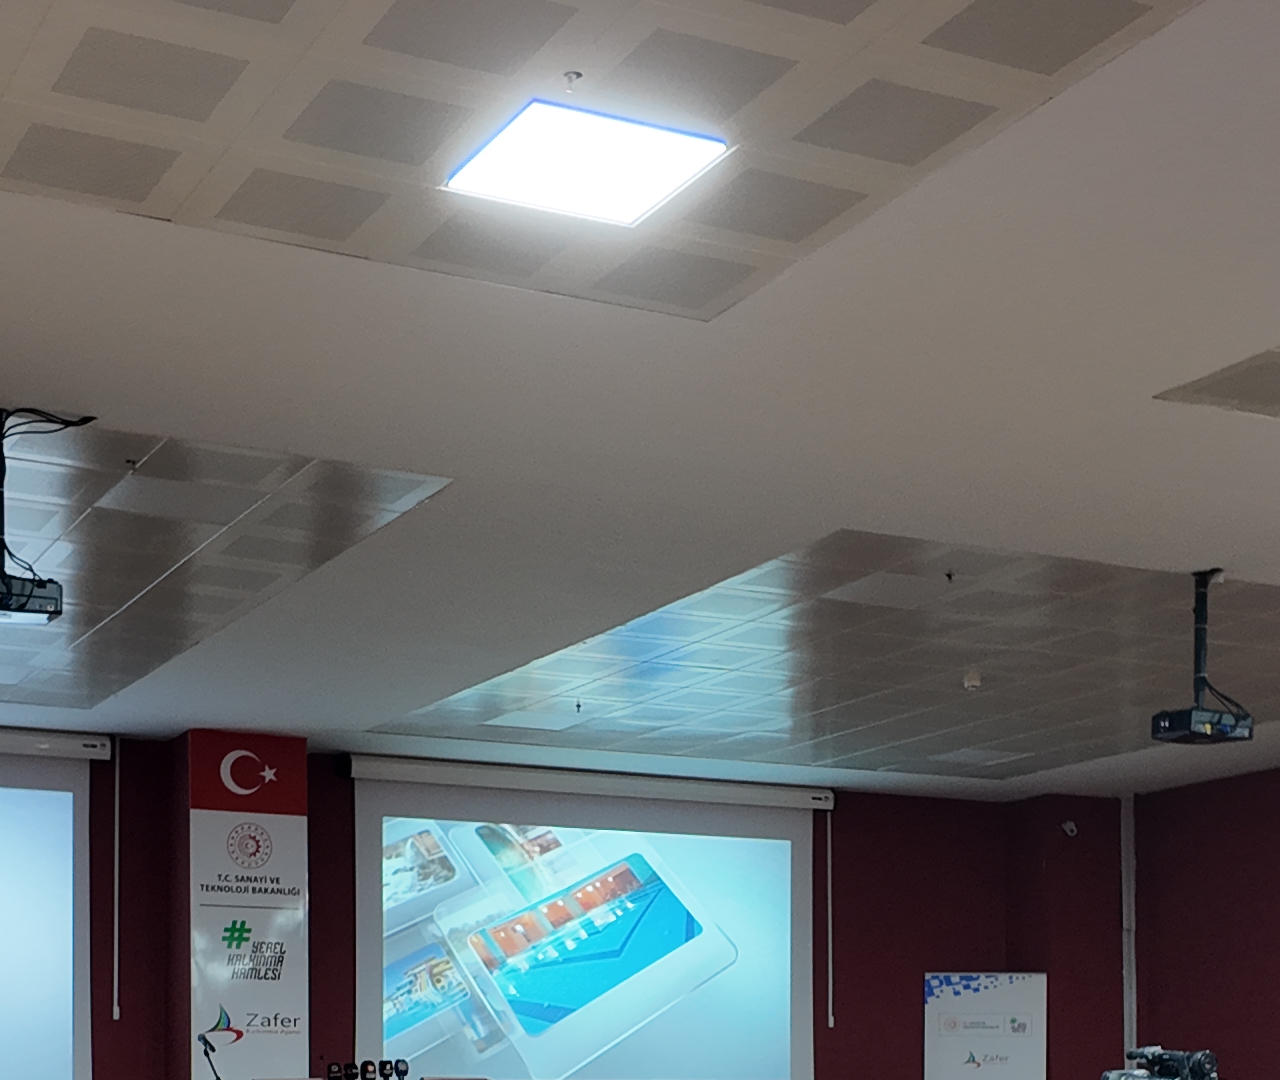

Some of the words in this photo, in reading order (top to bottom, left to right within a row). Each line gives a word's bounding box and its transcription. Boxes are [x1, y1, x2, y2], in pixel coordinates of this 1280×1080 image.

[234, 875, 268, 884] SANAYİ
[269, 876, 281, 885] VE
[200, 884, 250, 894] TEKNOLOJİ
[251, 886, 300, 896] BAKANLIĞI
[251, 941, 286, 954] YEREL
[246, 1013, 301, 1028] Zafer
